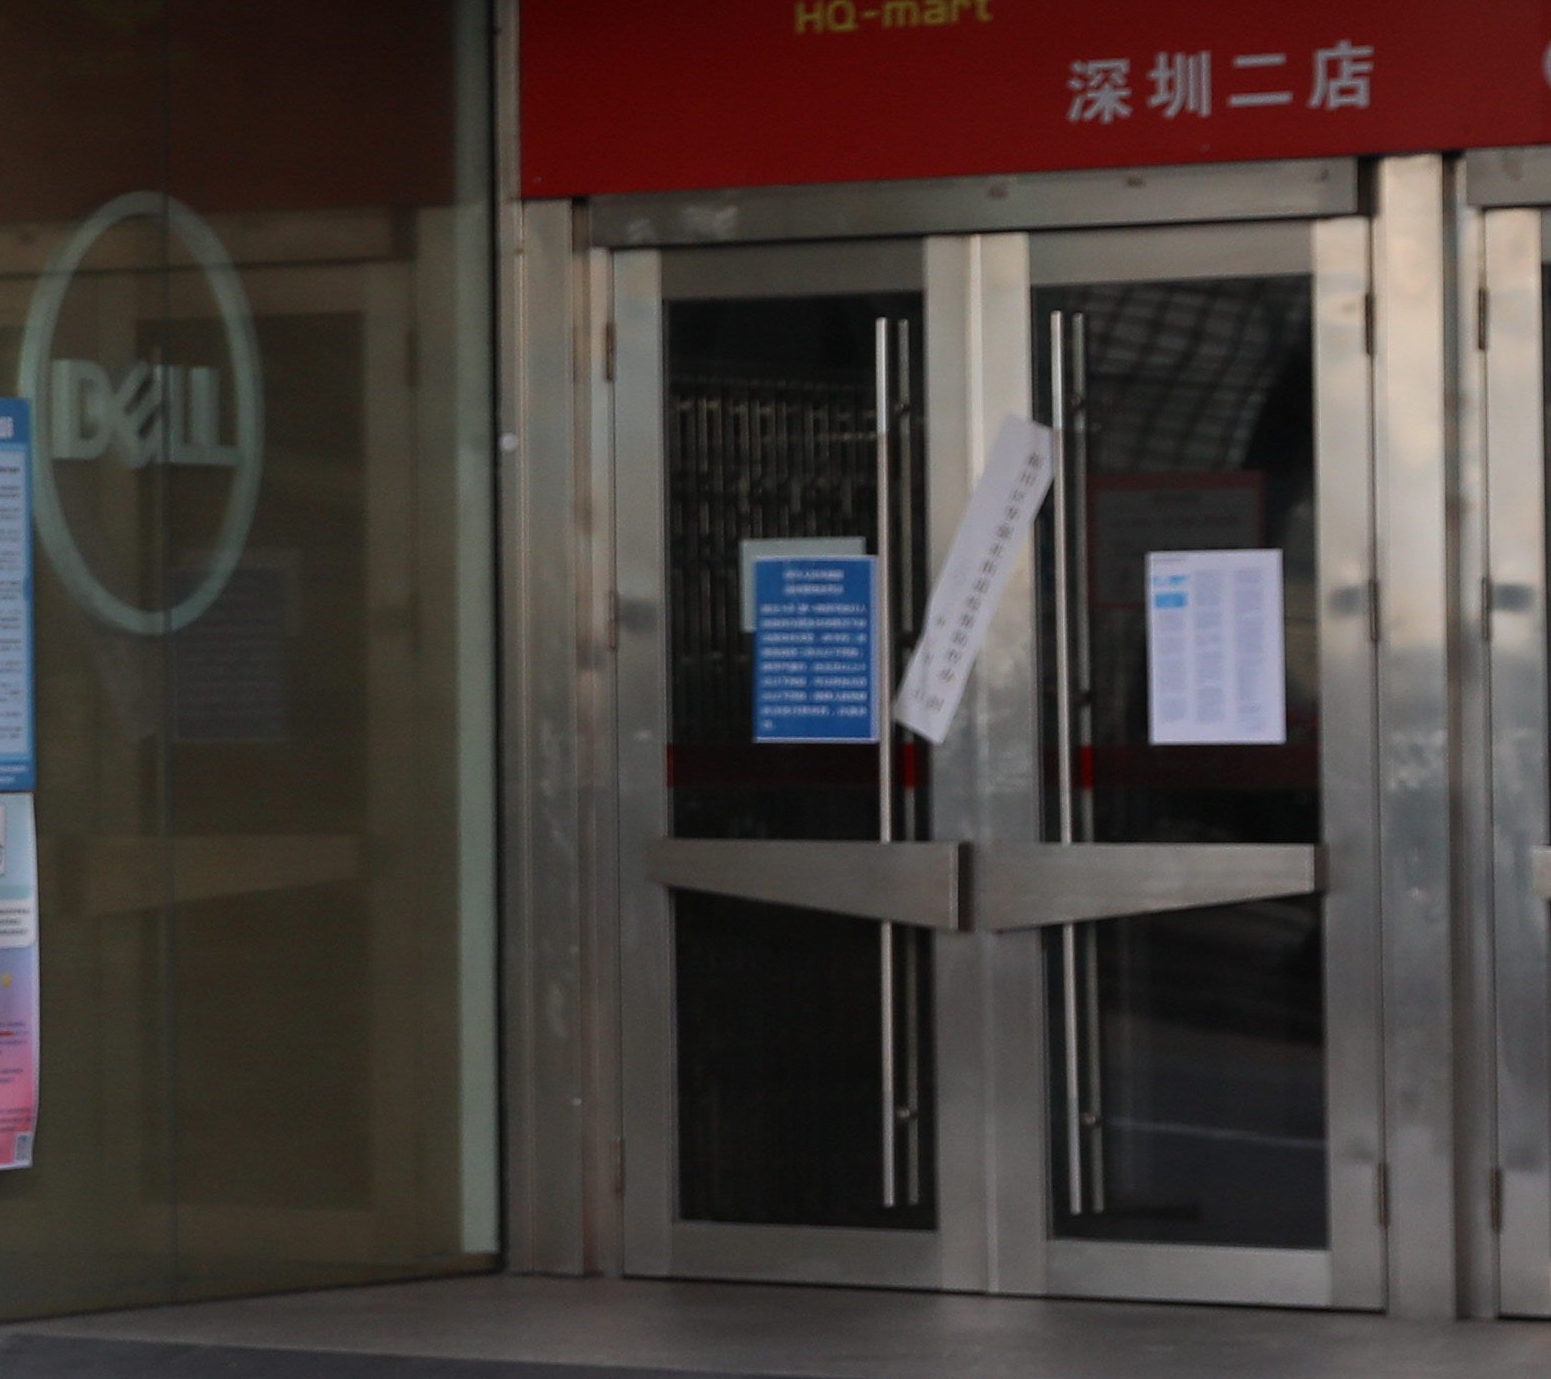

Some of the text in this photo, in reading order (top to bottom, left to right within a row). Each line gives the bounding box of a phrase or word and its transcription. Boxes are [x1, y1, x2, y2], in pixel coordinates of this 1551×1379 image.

[1066, 39, 1375, 125] 深圳二店
[51, 357, 240, 467] DELL
